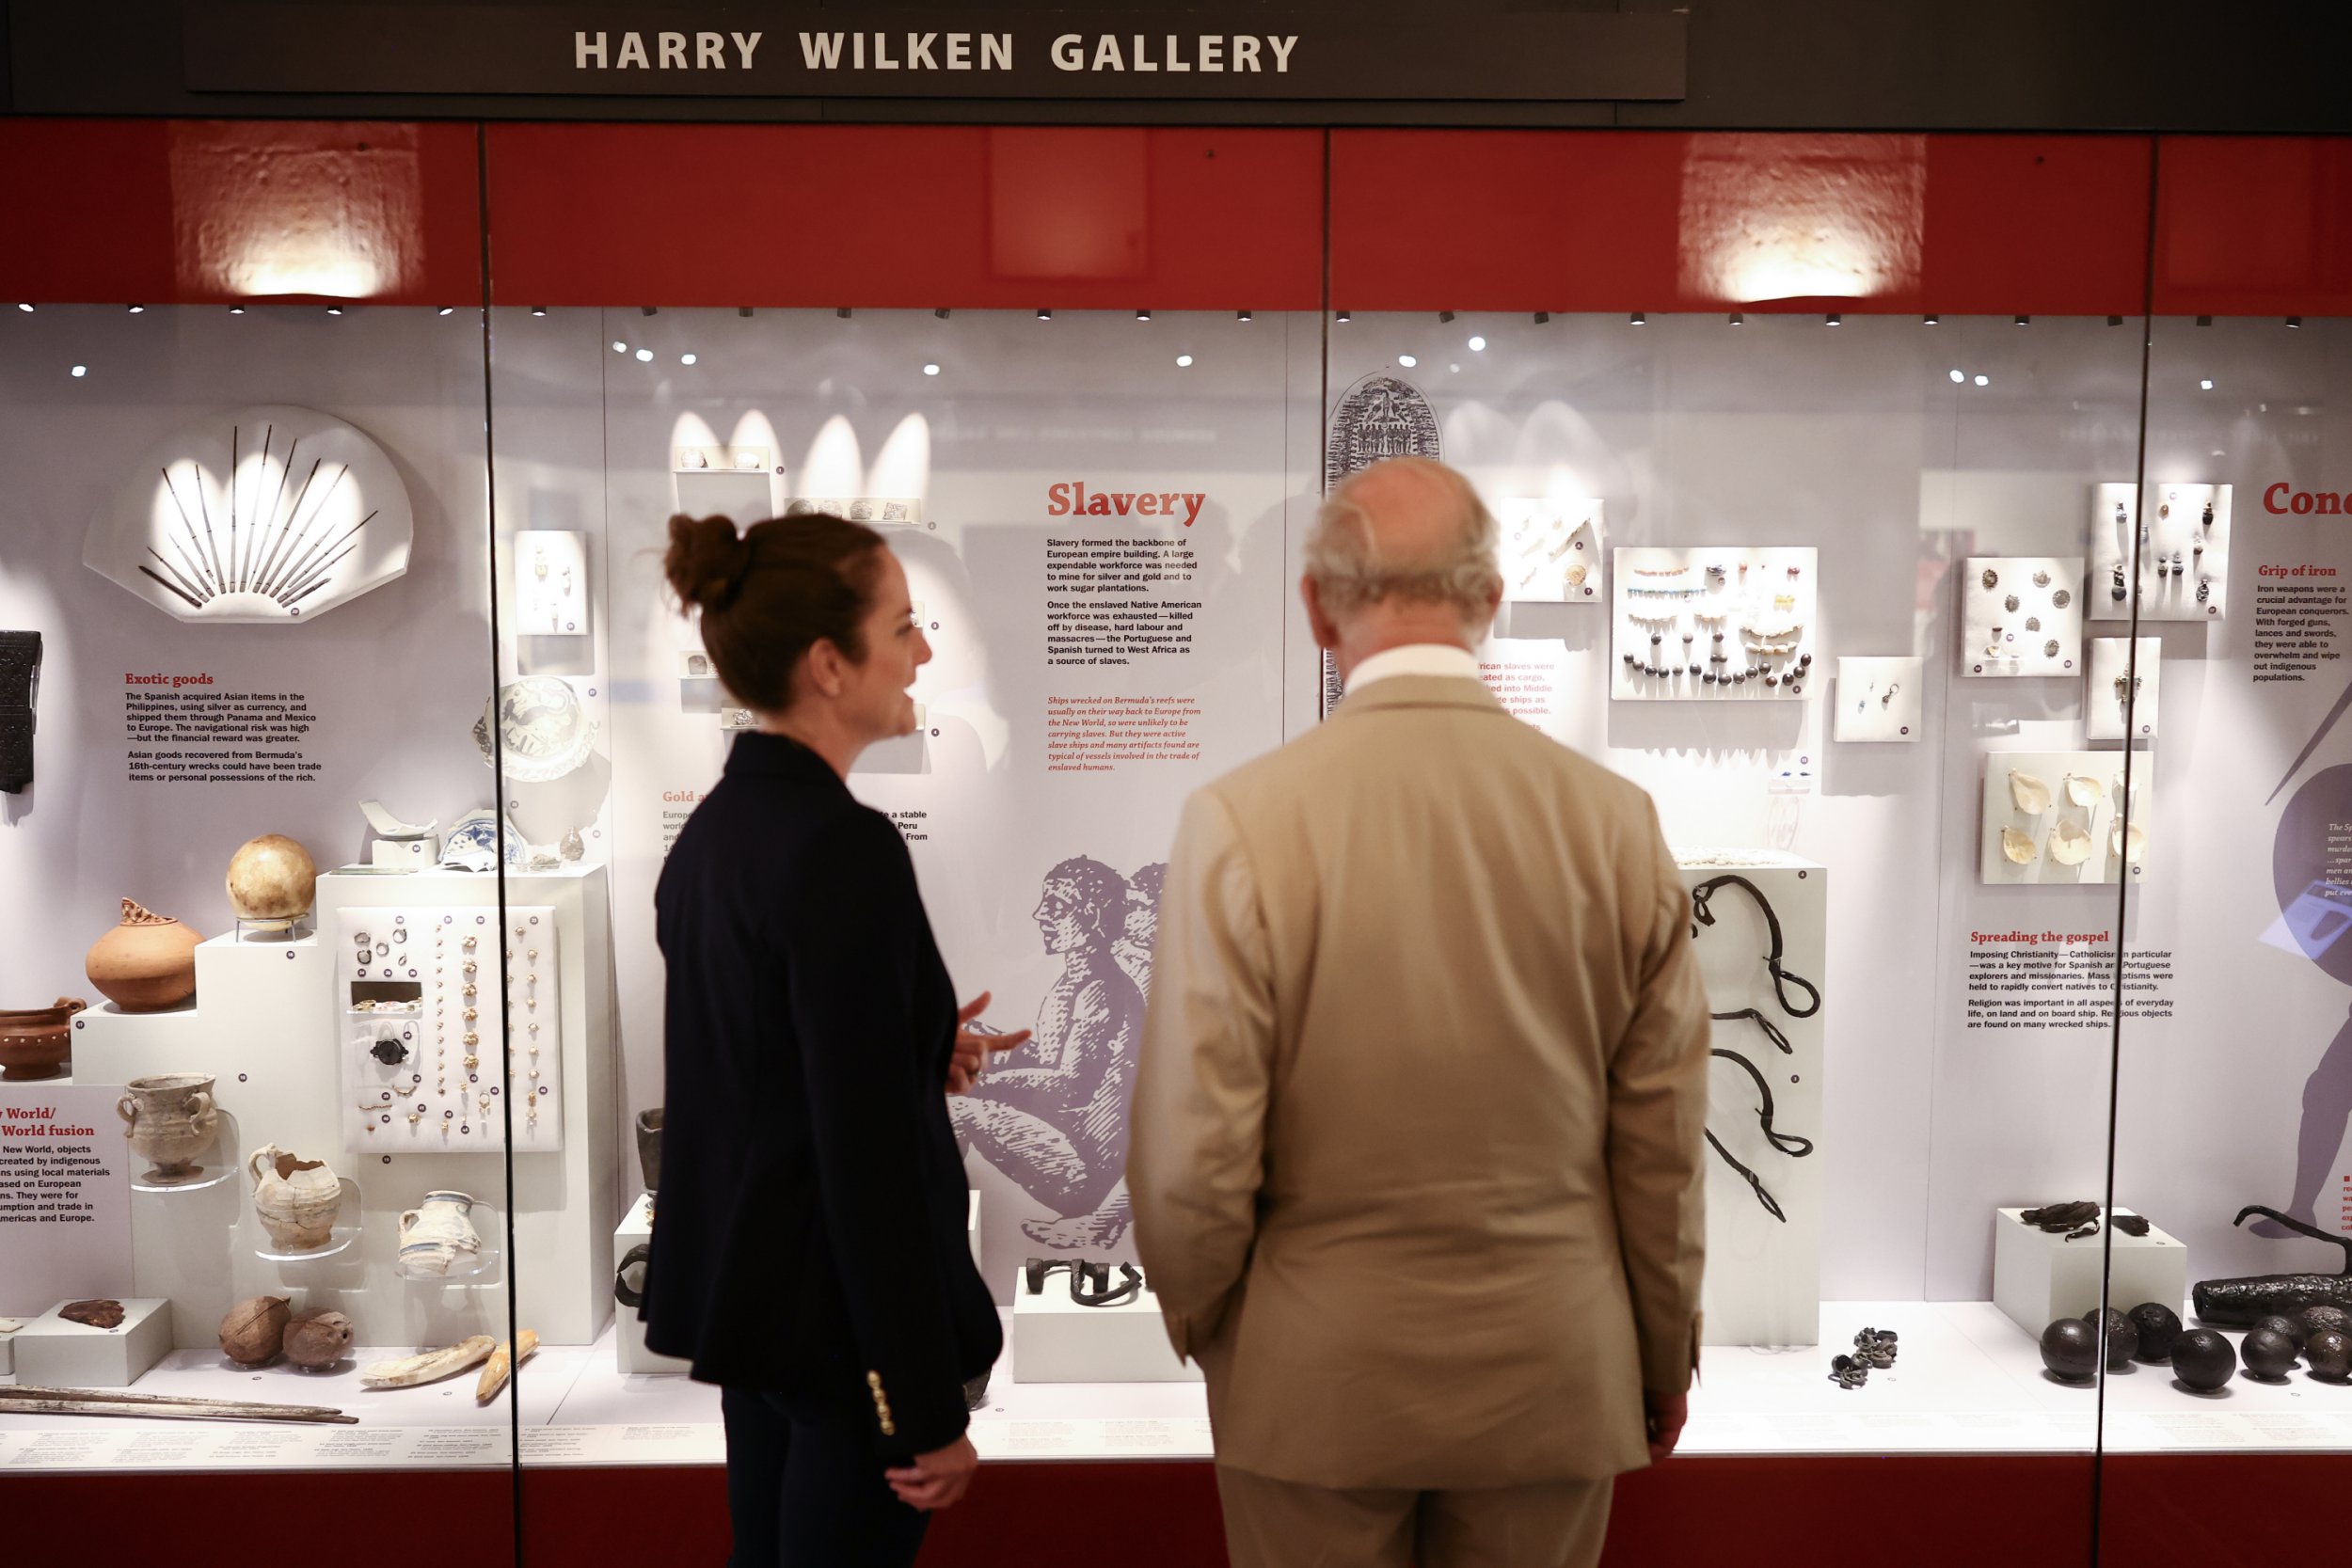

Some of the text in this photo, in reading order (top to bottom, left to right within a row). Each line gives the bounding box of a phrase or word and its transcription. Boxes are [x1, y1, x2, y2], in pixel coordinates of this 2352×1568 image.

[576, 32, 1297, 72] HARRY WILKEN GALLERY
[1048, 482, 1205, 528] Slavery
[1046, 538, 1079, 548] Slavery
[1081, 538, 1113, 546] formed
[1177, 538, 1186, 546] of
[1047, 550, 1089, 560] European
[1090, 550, 1121, 560] empire
[1123, 550, 1161, 560] building.
[1172, 550, 1194, 559] large
[1046, 562, 1097, 571] expendable
[2258, 564, 2336, 579] Grip of iron
[2277, 586, 2314, 594] weapons
[1047, 600, 1070, 609] Once
[1161, 600, 1202, 609] American
[2287, 596, 2332, 606] advantage
[2256, 607, 2296, 616] European
[1047, 623, 1183, 633] off by disease, hard labour and
[2256, 618, 2330, 628] With forged guns,
[2304, 629, 2337, 638] swords,
[1048, 645, 1082, 655] Spanish
[1085, 645, 1114, 654] turned
[1127, 645, 1150, 654] West
[1152, 645, 1177, 654] Africa
[2254, 641, 2274, 650] they
[2298, 640, 2317, 648] able
[2254, 651, 2341, 660] overwhelm and wipe
[125, 673, 214, 689] Exotic goods
[125, 692, 141, 701] The
[144, 692, 181, 702] Spanish
[183, 692, 222, 702] acquired
[224, 692, 248, 701] Asian
[1048, 696, 1069, 705] Ships
[1156, 696, 1175, 705] reefs
[126, 703, 178, 712] Philippines,
[181, 704, 205, 713] using
[246, 705, 287, 713] currency,
[126, 713, 316, 722] shipped them through Panama and Mexico
[662, 790, 694, 801] Gold
[2328, 823, 2343, 832] The
[2326, 877, 2349, 885] bellies
[1971, 930, 2108, 946] Spreading the gospel
[1970, 951, 2009, 959] Imposing
[2131, 950, 2171, 959] particular
[2006, 961, 2021, 971] key
[2069, 961, 2103, 970] Spanish
[2122, 961, 2171, 971] Portuguese
[1969, 973, 2009, 981] explorers
[2028, 972, 2085, 980] missionaries.
[2088, 972, 2111, 980] Mass
[2086, 1021, 2111, 1029] ships.
[6, 1107, 56, 1119] World/
[1, 1124, 94, 1136] World fusion
[24, 1146, 55, 1154] World,
[56, 1146, 91, 1155] objects
[37, 1157, 48, 1166] by
[50, 1157, 101, 1166] indigenous
[40, 1213, 94, 1223] and Europe.
